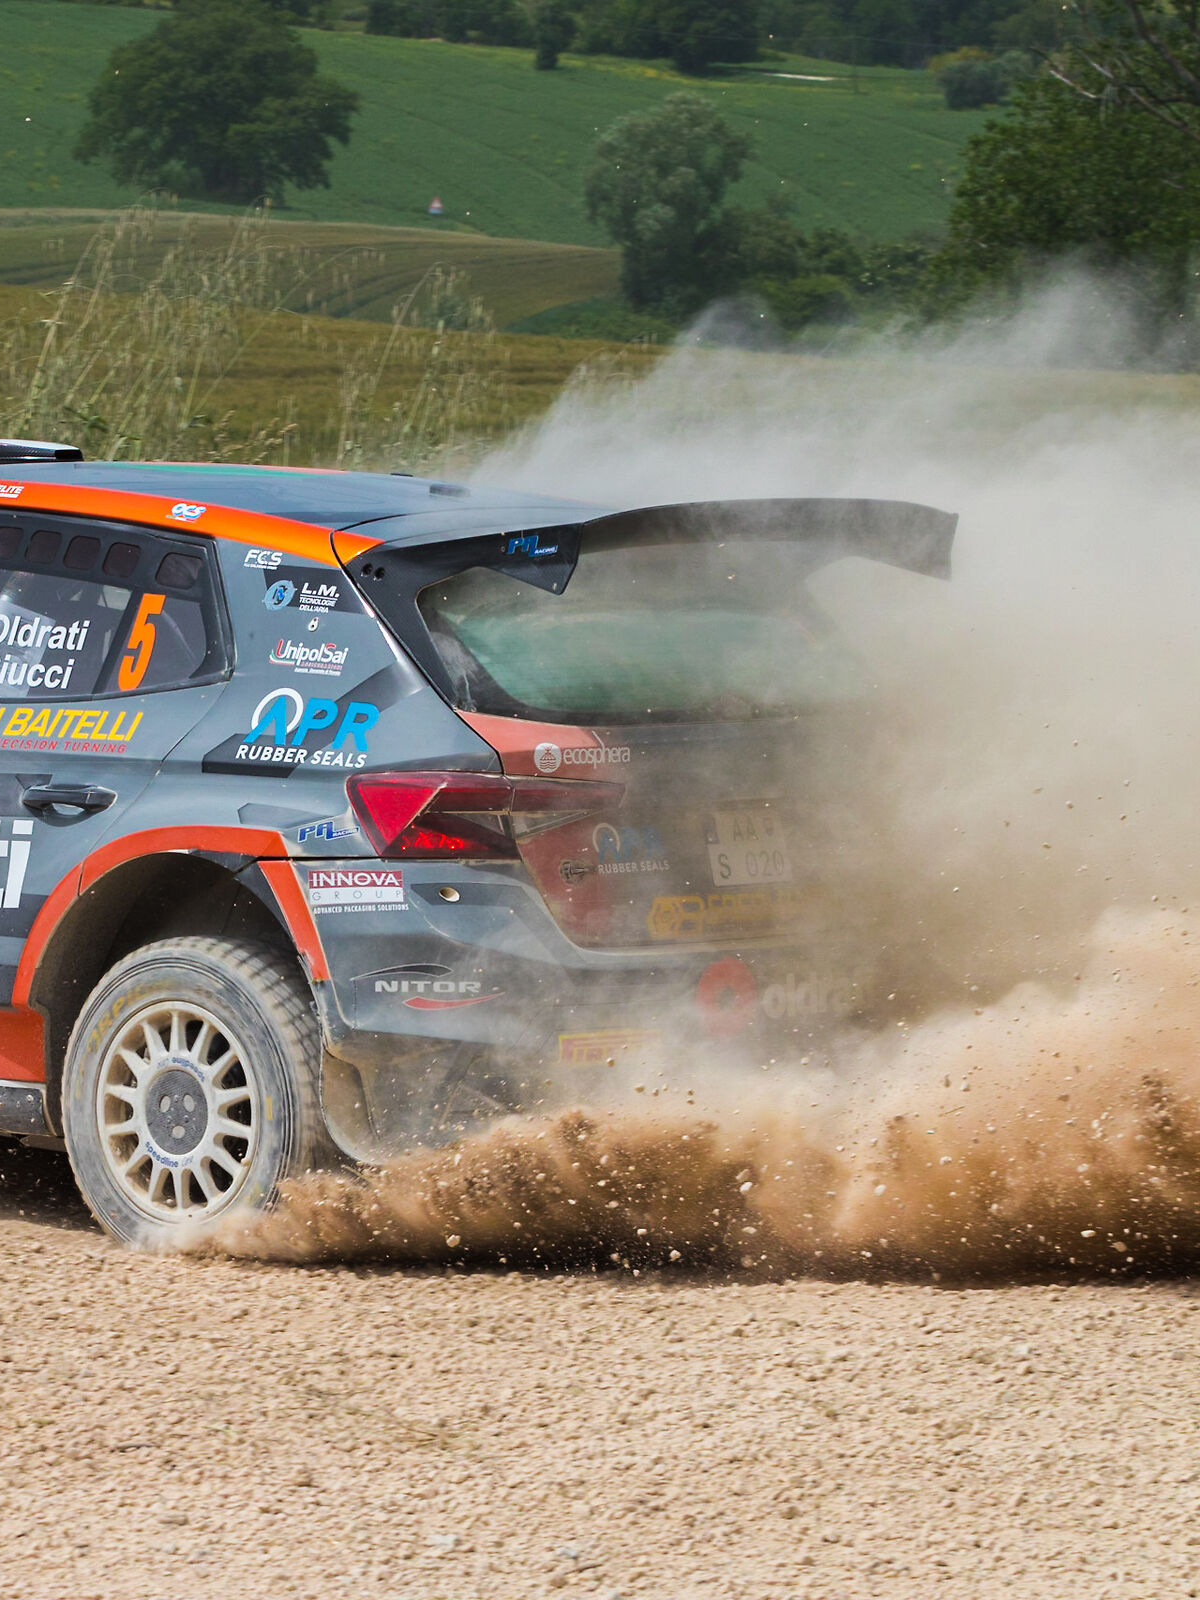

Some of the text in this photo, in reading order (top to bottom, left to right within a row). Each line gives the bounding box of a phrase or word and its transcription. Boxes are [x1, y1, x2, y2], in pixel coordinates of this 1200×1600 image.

[301, 582, 340, 598] L.M.
[118, 594, 166, 691] 5
[276, 639, 349, 666] UnipolSai
[2, 707, 144, 742] BAITELLI
[243, 688, 380, 752] APR
[63, 741, 128, 753] TURNING
[235, 745, 368, 769] RUBBER SEALS
[563, 731, 631, 769] ecosphera
[598, 860, 670, 875] RUBBER SEALS
[311, 872, 400, 887] INNOVA
[312, 890, 401, 901] GROUP
[313, 903, 409, 914] ADVANCED PACKAGING SOLUTIONS
[375, 980, 481, 993] NITOR
[145, 1141, 179, 1167] speedline
